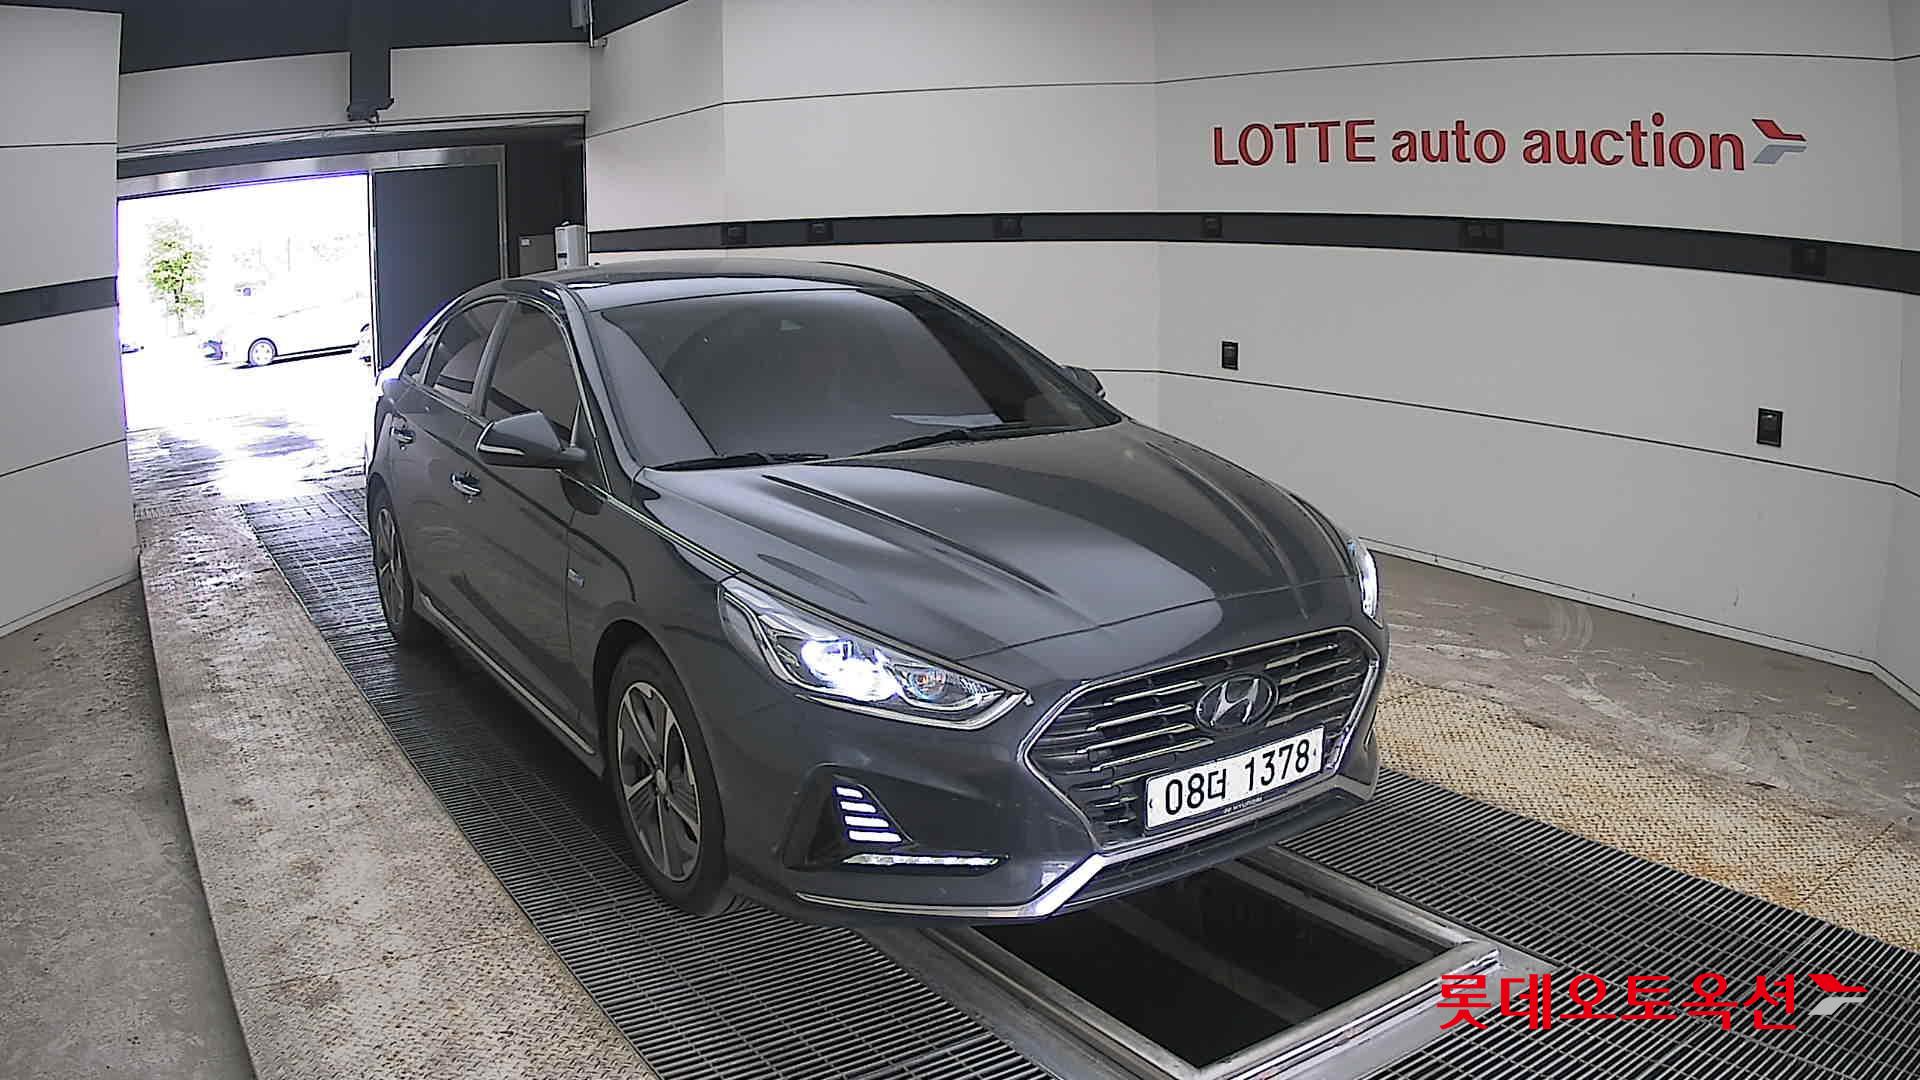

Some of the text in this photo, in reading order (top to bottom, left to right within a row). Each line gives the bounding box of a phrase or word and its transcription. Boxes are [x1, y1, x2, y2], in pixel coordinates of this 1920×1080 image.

[1213, 112, 1745, 171] LOTTE auto auction
[1165, 738, 1311, 816] 08더 1378
